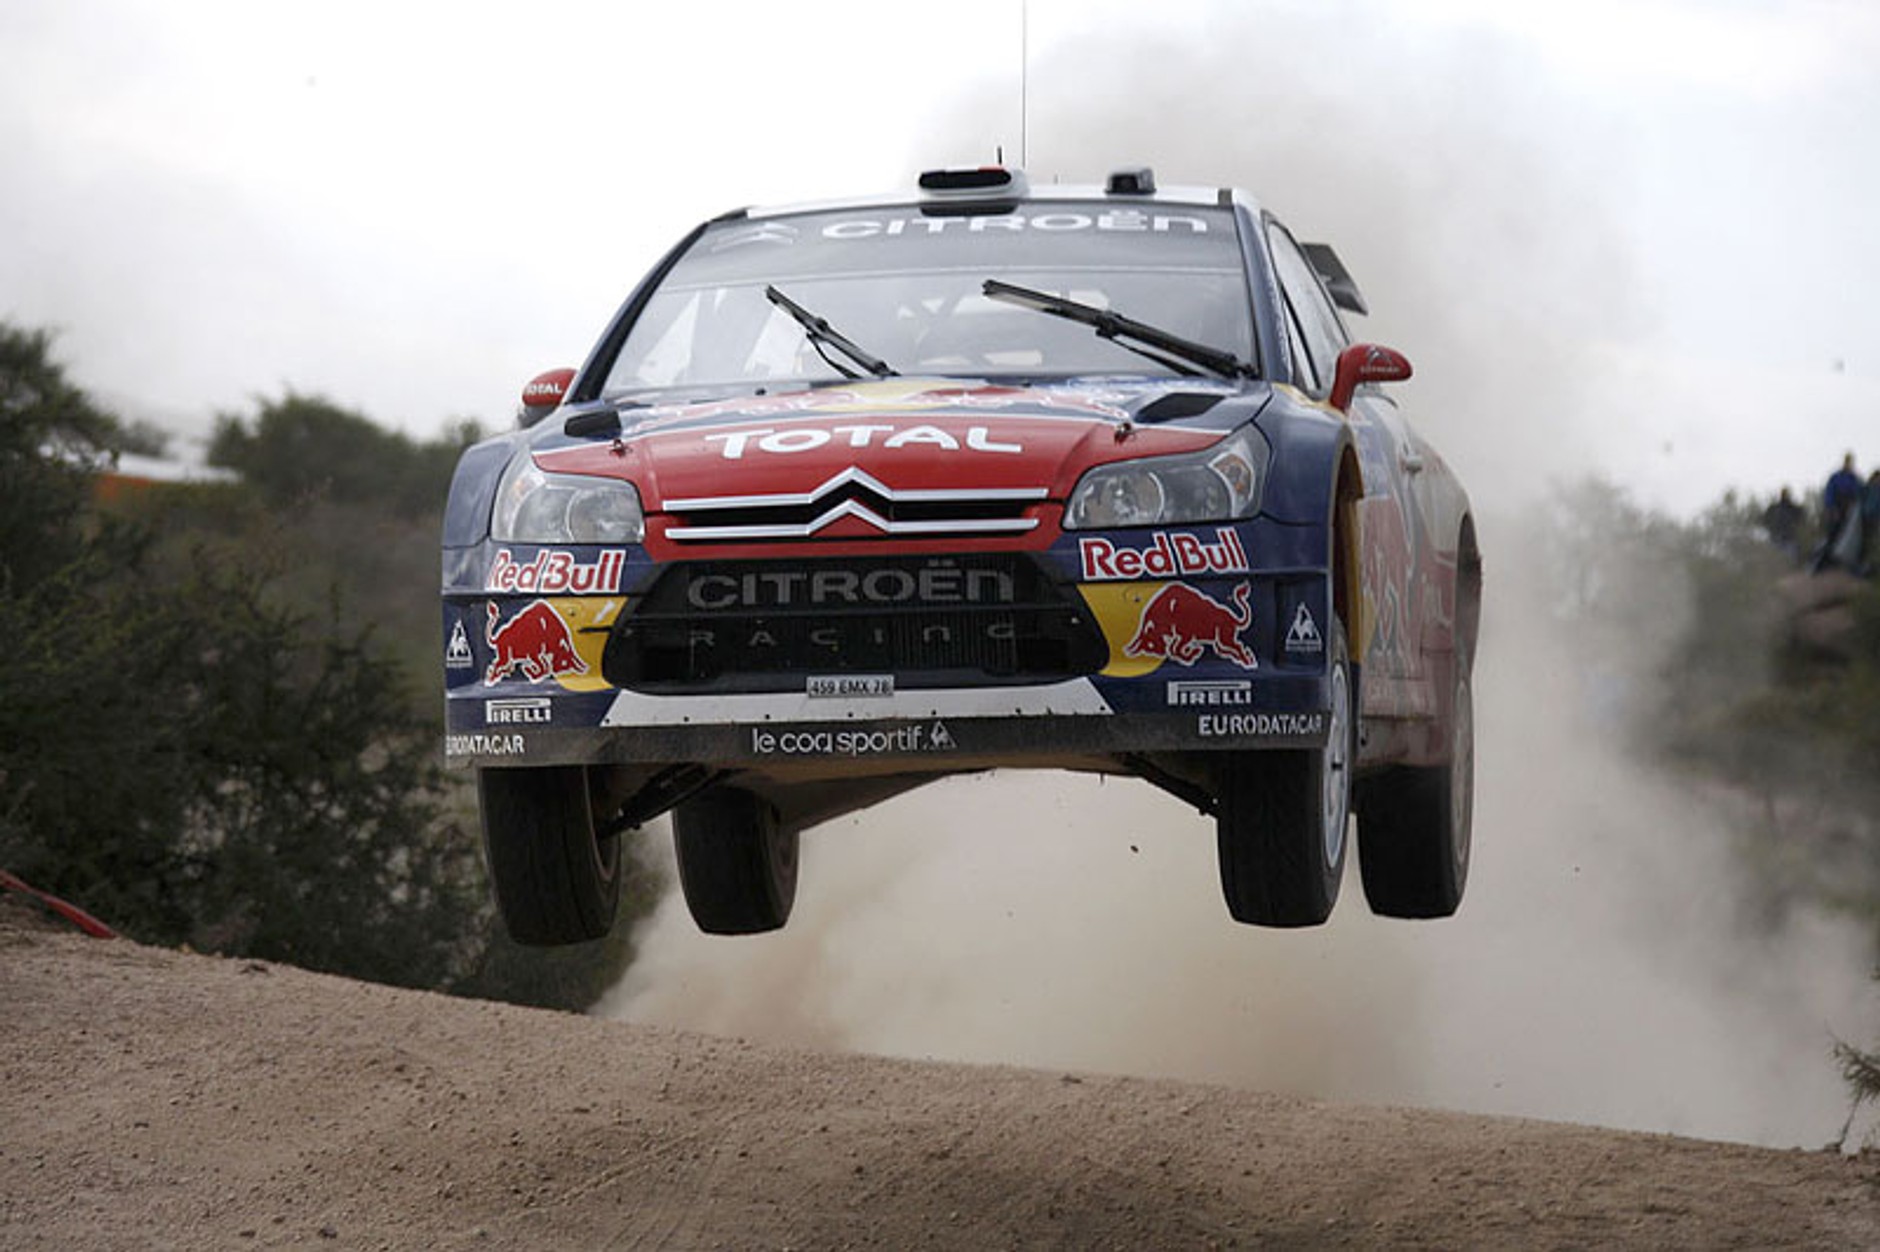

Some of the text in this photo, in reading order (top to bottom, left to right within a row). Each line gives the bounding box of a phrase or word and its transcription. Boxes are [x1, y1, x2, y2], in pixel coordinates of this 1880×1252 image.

[705, 424, 1022, 459] TOTAL
[1079, 526, 1249, 580] Red Bull
[538, 549, 626, 593] Bull
[1168, 681, 1251, 705] PIRELLI
[486, 698, 551, 723] PIRELLI
[1199, 714, 1322, 736] EURODATACAR
[752, 728, 776, 753] le
[837, 725, 922, 757] sportif
